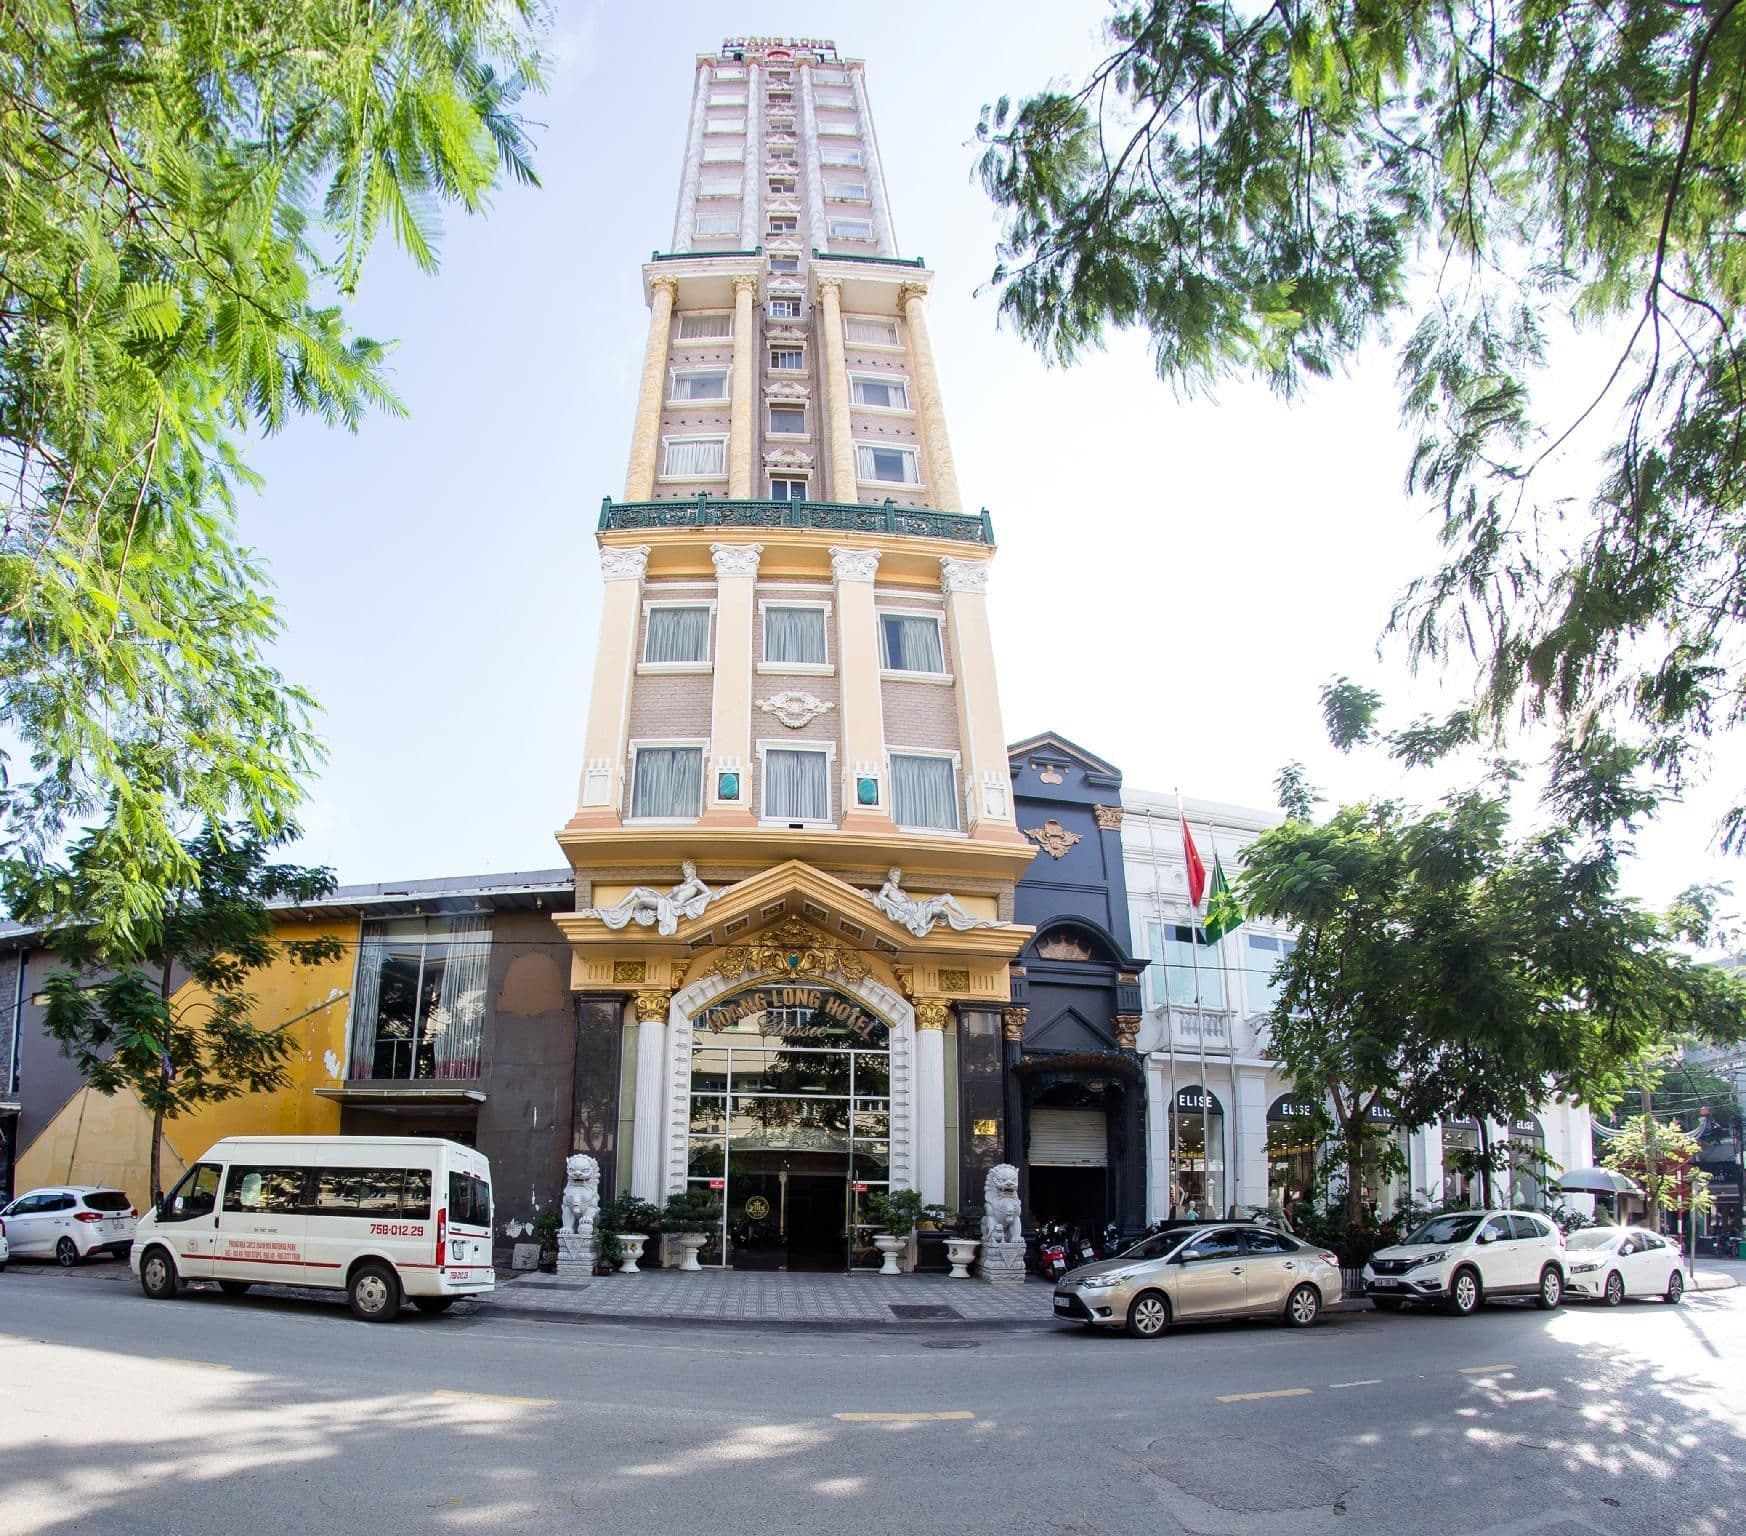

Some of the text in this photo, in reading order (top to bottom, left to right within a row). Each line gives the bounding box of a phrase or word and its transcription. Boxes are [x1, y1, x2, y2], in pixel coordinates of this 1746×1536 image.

[707, 988, 876, 1039] HOANG LONG HOTEL
[1179, 1095, 1213, 1108] ELISE
[1371, 1106, 1396, 1118] ELIS
